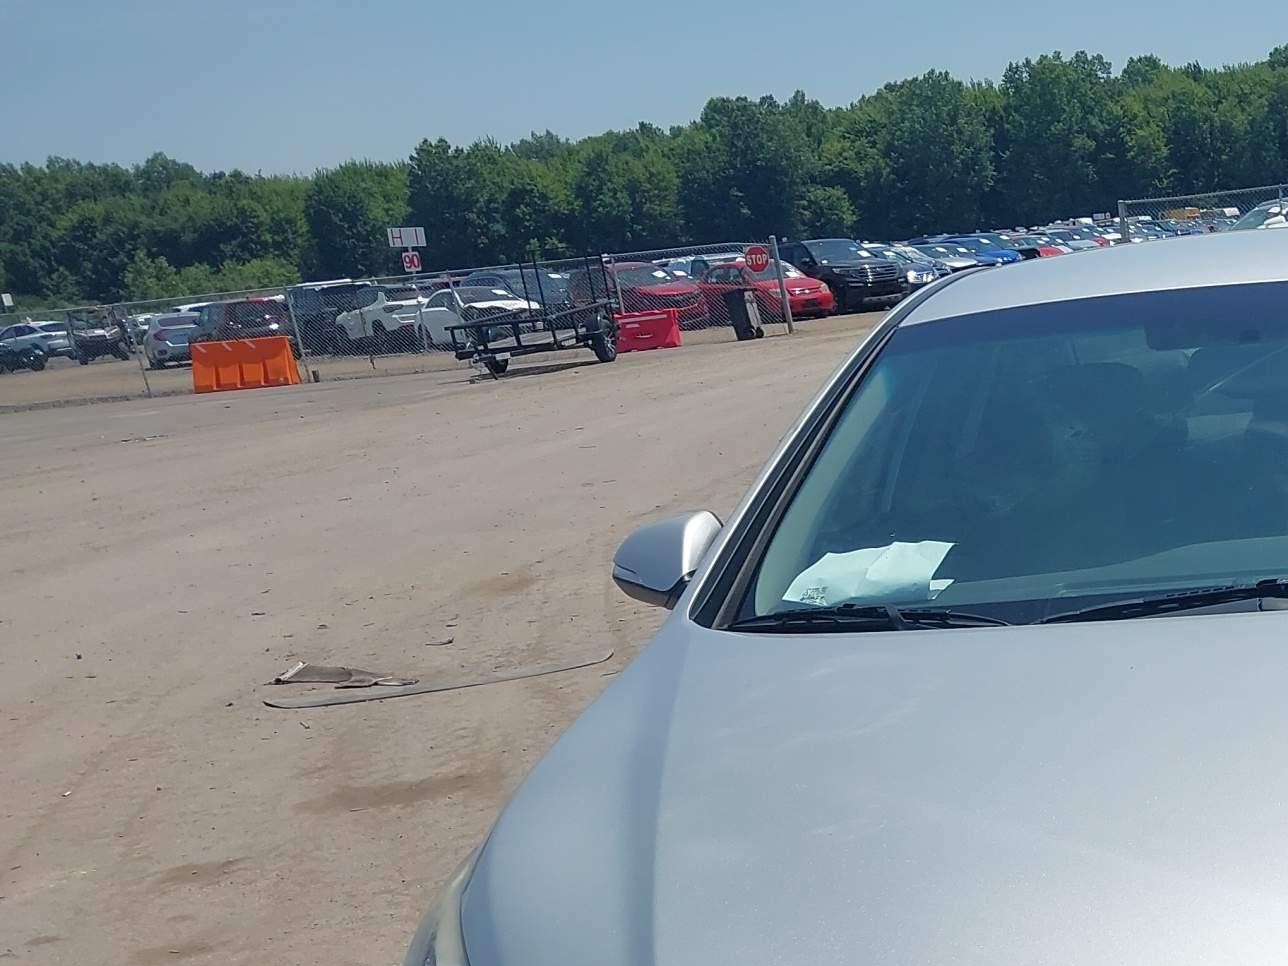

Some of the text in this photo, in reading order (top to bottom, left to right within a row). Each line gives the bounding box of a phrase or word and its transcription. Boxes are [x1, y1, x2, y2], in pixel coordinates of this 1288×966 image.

[391, 229, 403, 246] H
[403, 254, 420, 269] 90
[746, 254, 767, 265] STOP
